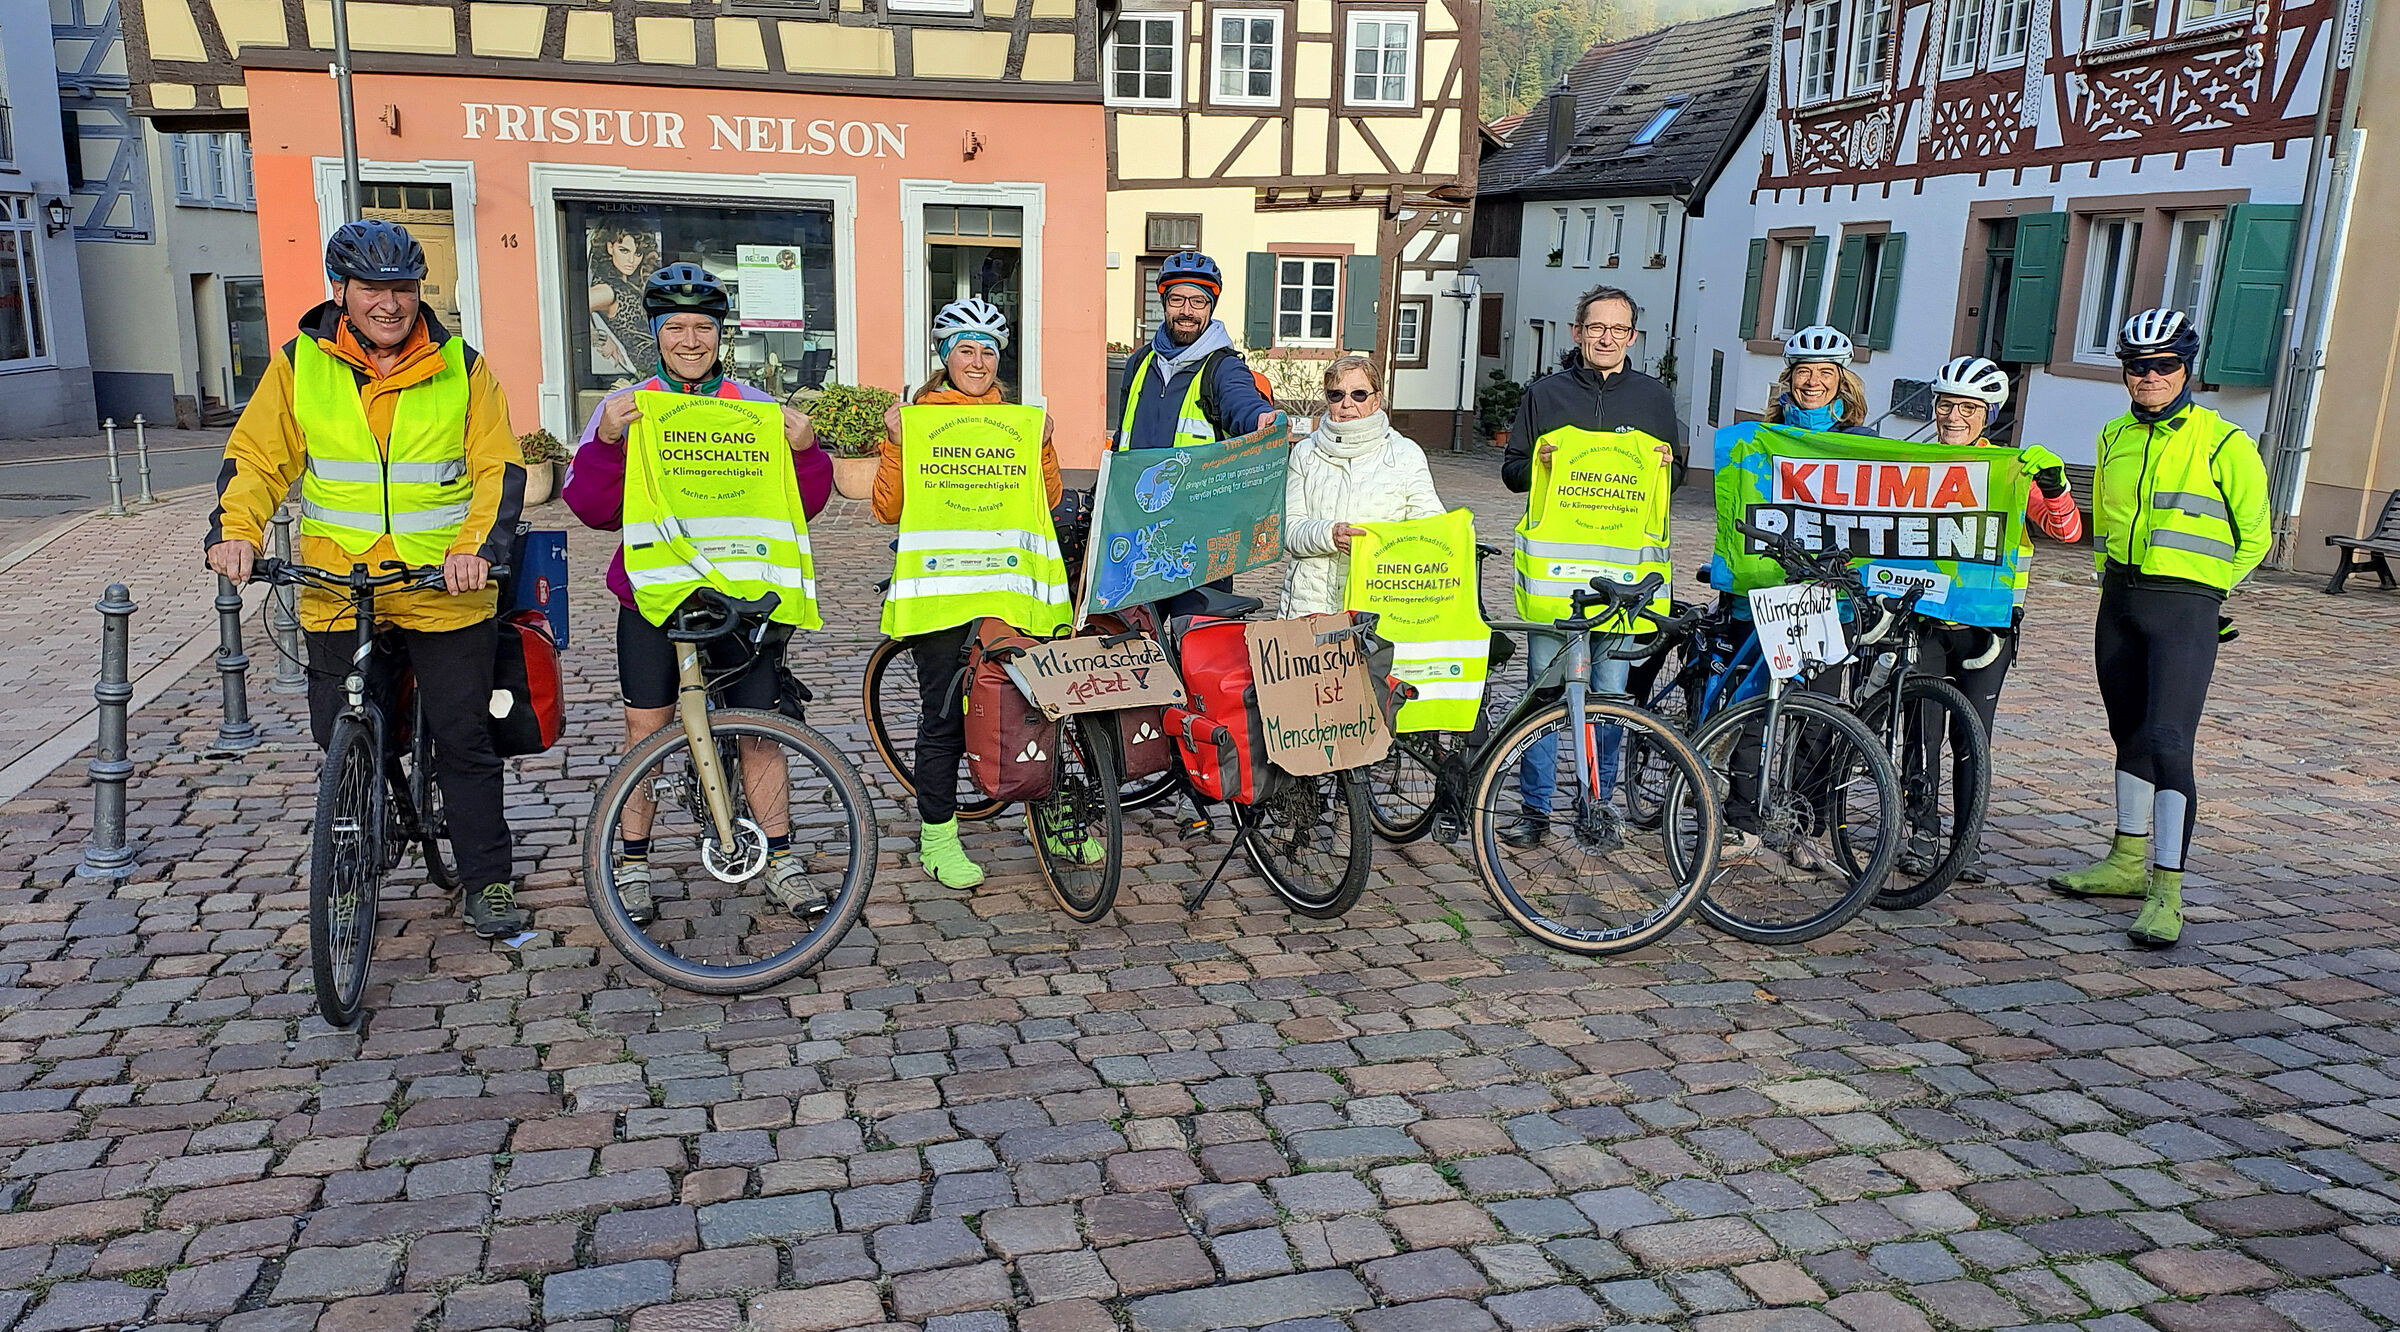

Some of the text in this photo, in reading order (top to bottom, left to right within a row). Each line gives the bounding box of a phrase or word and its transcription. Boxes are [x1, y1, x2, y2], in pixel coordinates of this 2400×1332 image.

[460, 102, 909, 159] FRISEUR NELSON
[663, 430, 756, 444] EINEN GANG
[928, 417, 1023, 443] Mitradel-Aktion: Road2COP31
[932, 446, 1015, 459] EINEN GANG
[672, 467, 763, 477] Klimagerechtigkeit
[920, 463, 1027, 476] HOCHSCHALTEN
[1570, 471, 1638, 485] EINEN GANG
[1779, 460, 1980, 509] KLIMA
[924, 480, 1020, 491] für Klimagerechtigkeit
[680, 487, 709, 500] Aachen
[717, 488, 746, 500] Antalya
[1557, 485, 1646, 501] HOCHSCHALTEN
[944, 499, 971, 512] Aachen
[977, 501, 1004, 512] Antalya
[1559, 500, 1639, 514] für Klimagerechtigkeit
[1575, 518, 1594, 530] Aachen
[1600, 522, 1624, 531] Antalya
[1754, 508, 2001, 562] RETTEN!
[1376, 562, 1449, 575] EINEN GANG
[1365, 576, 1461, 591] HOCHSCHALTEN
[1894, 575, 1936, 589] BUND
[1369, 594, 1455, 604] für Klimagerechtigkeit
[1753, 587, 1832, 626] Klimaschutz
[1388, 612, 1411, 625] Aachen
[1416, 614, 1440, 625] Antalya
[1786, 618, 1808, 645] geht
[1030, 640, 1166, 678] Klimaschutz
[1258, 637, 1366, 685] Klimaschu
[1773, 644, 1794, 670] alle
[1314, 677, 1344, 708] ist
[1266, 703, 1377, 753] Menschenrecht
